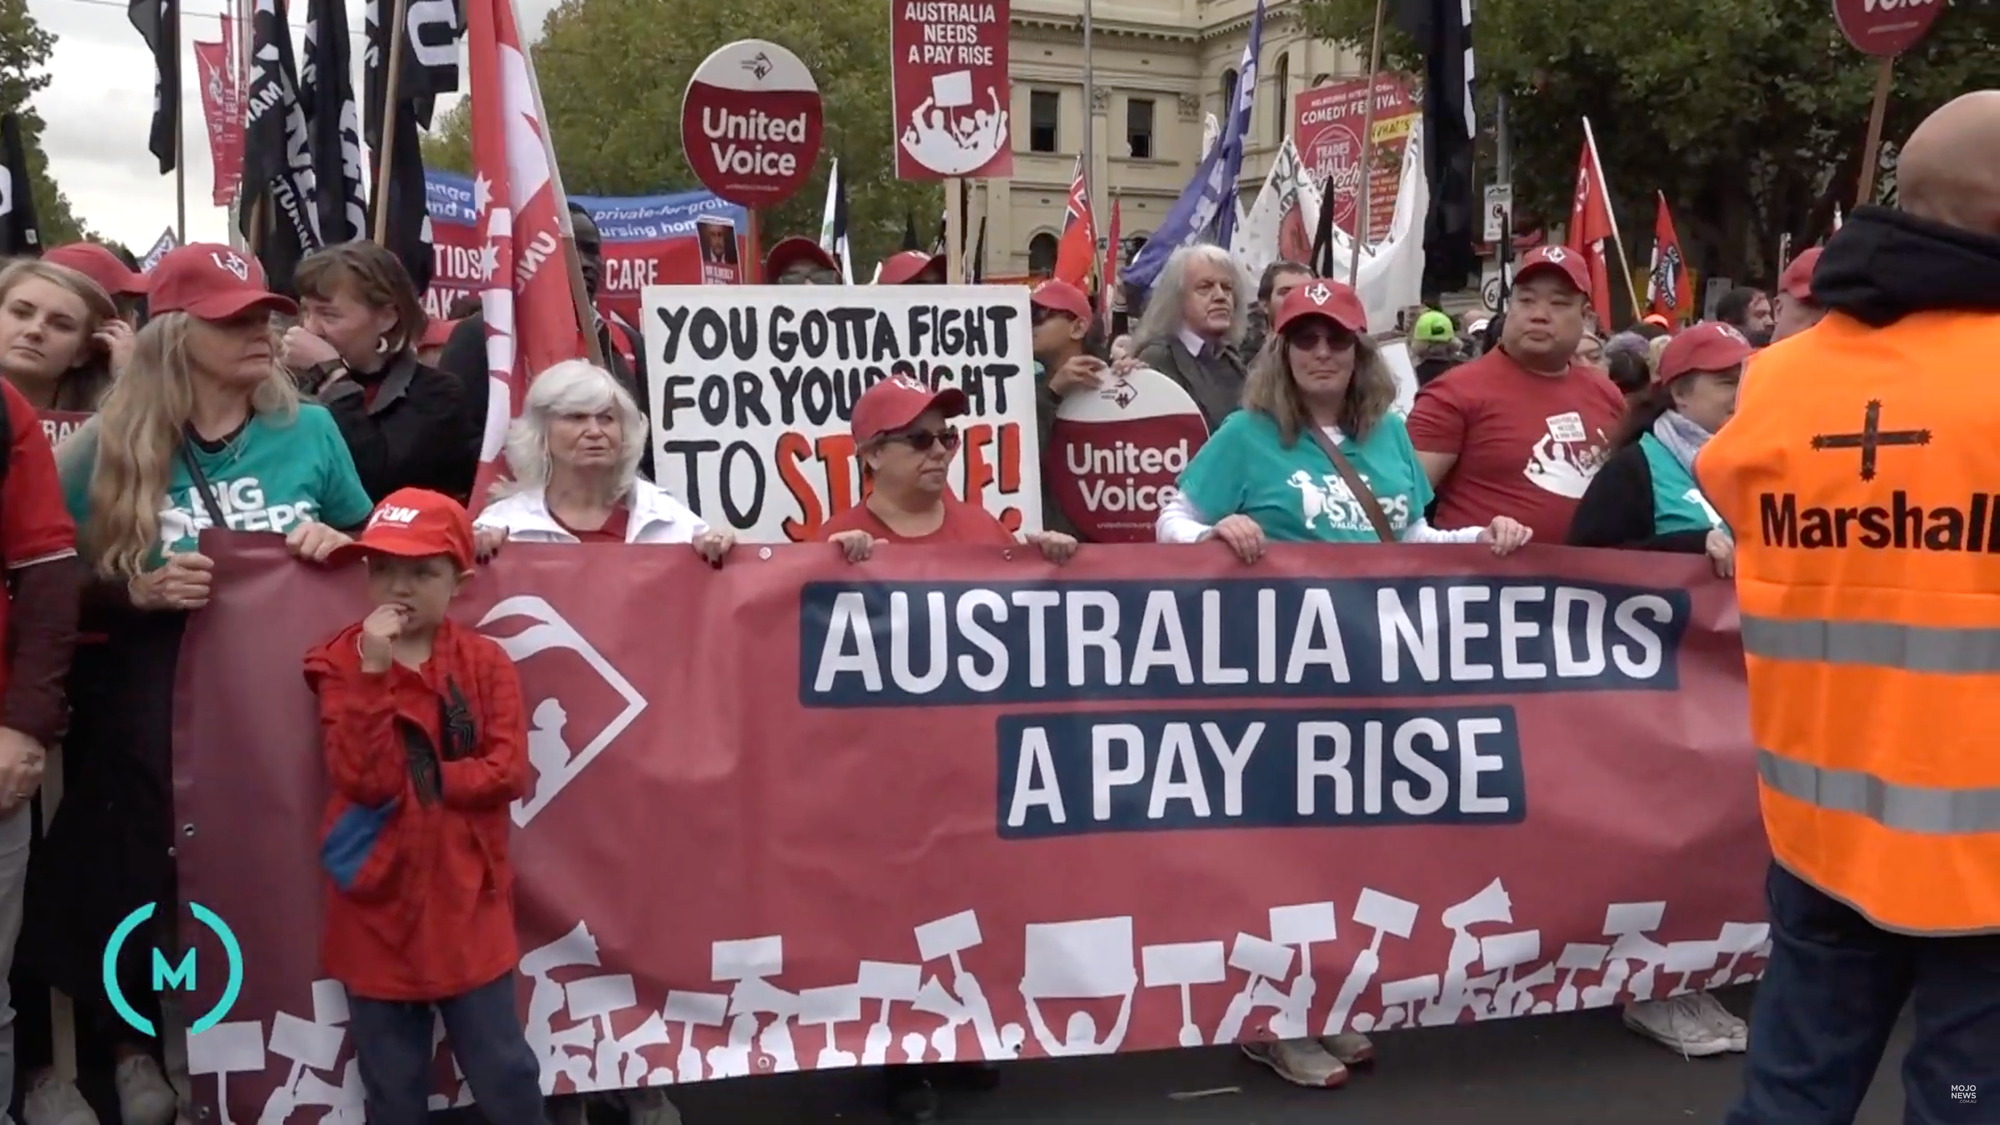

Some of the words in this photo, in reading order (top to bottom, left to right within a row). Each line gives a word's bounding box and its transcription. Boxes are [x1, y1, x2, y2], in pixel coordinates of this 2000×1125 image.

[904, 2, 996, 23] AUSTRALIA
[924, 24, 978, 44] NEEDS
[908, 44, 920, 64] A
[924, 45, 954, 65] PAY
[958, 45, 994, 66] RISE
[702, 106, 807, 144] United
[1301, 104, 1348, 126] COMEDY
[1350, 91, 1403, 116] FESIVAL
[710, 142, 797, 177] Voice
[1317, 155, 1351, 177] HALL
[606, 258, 659, 291] CARE
[656, 305, 759, 365] YOU
[768, 304, 900, 364] GOTTA
[907, 304, 1018, 359] FIGHT
[662, 370, 772, 432] FOR
[1066, 438, 1188, 476] United
[663, 440, 766, 530] TO
[1077, 477, 1181, 512] Voice
[813, 588, 1351, 695] AUSTRALIA
[1377, 585, 1674, 683] NEEDS
[1006, 725, 1066, 828] A
[1090, 721, 1265, 821] PAY
[1295, 716, 1510, 815] RISE
